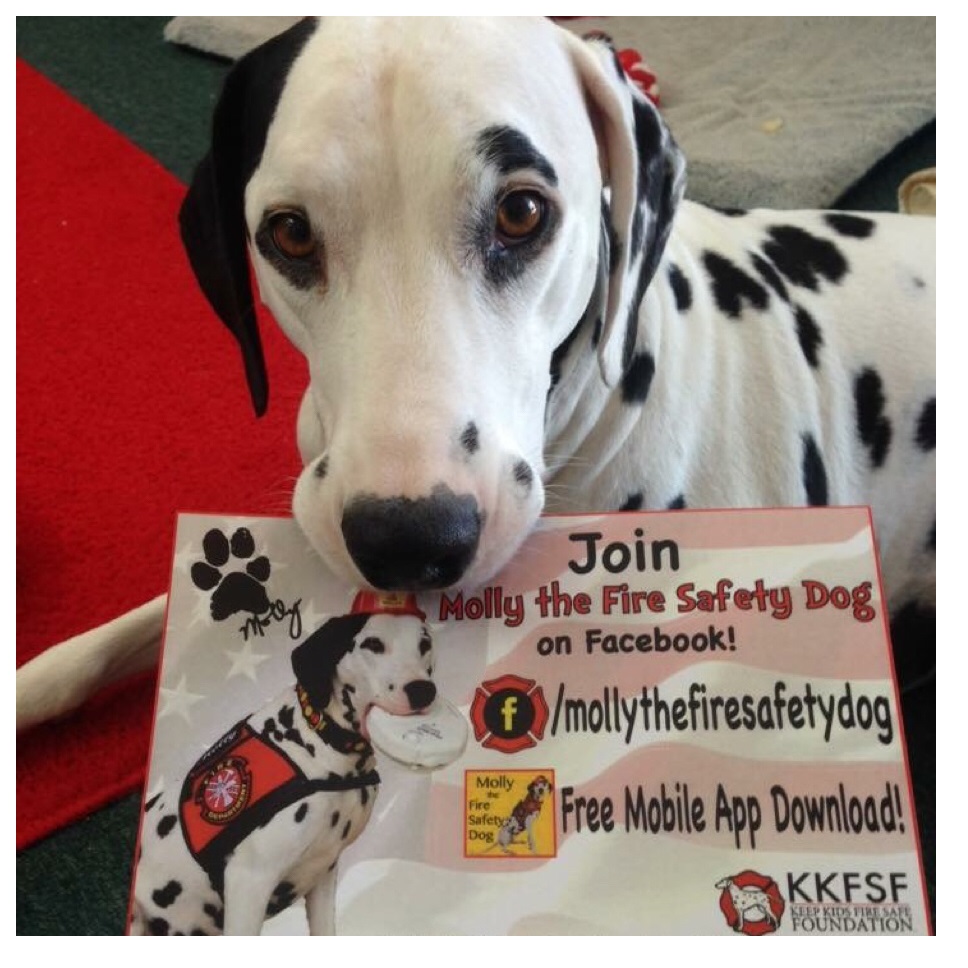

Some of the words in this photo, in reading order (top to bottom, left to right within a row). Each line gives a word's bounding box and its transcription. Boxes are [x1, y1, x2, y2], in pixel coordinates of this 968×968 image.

[568, 529, 680, 575] Join
[439, 586, 525, 627] Molly
[534, 581, 591, 617] the
[601, 582, 666, 615] Fire
[677, 579, 791, 620] Safety
[801, 579, 878, 623] Dog
[536, 636, 573, 656] on
[584, 626, 738, 655] Facebook!
[550, 681, 894, 745] /mollythefiresafetydog
[476, 775, 514, 792] Molly
[487, 790, 500, 799] the
[469, 800, 491, 811] Fire
[469, 814, 503, 828] Safety
[561, 786, 614, 833] Free
[624, 784, 705, 833] Mobile
[714, 784, 762, 850] App
[771, 782, 906, 834] Download!
[469, 830, 494, 843] Dog
[787, 871, 908, 904] KKFSF
[791, 906, 820, 917] KEEP
[823, 906, 850, 917] KIDS
[853, 906, 880, 917] FIRE
[882, 906, 911, 917] SAFE
[792, 916, 914, 932] FOUNDATION
